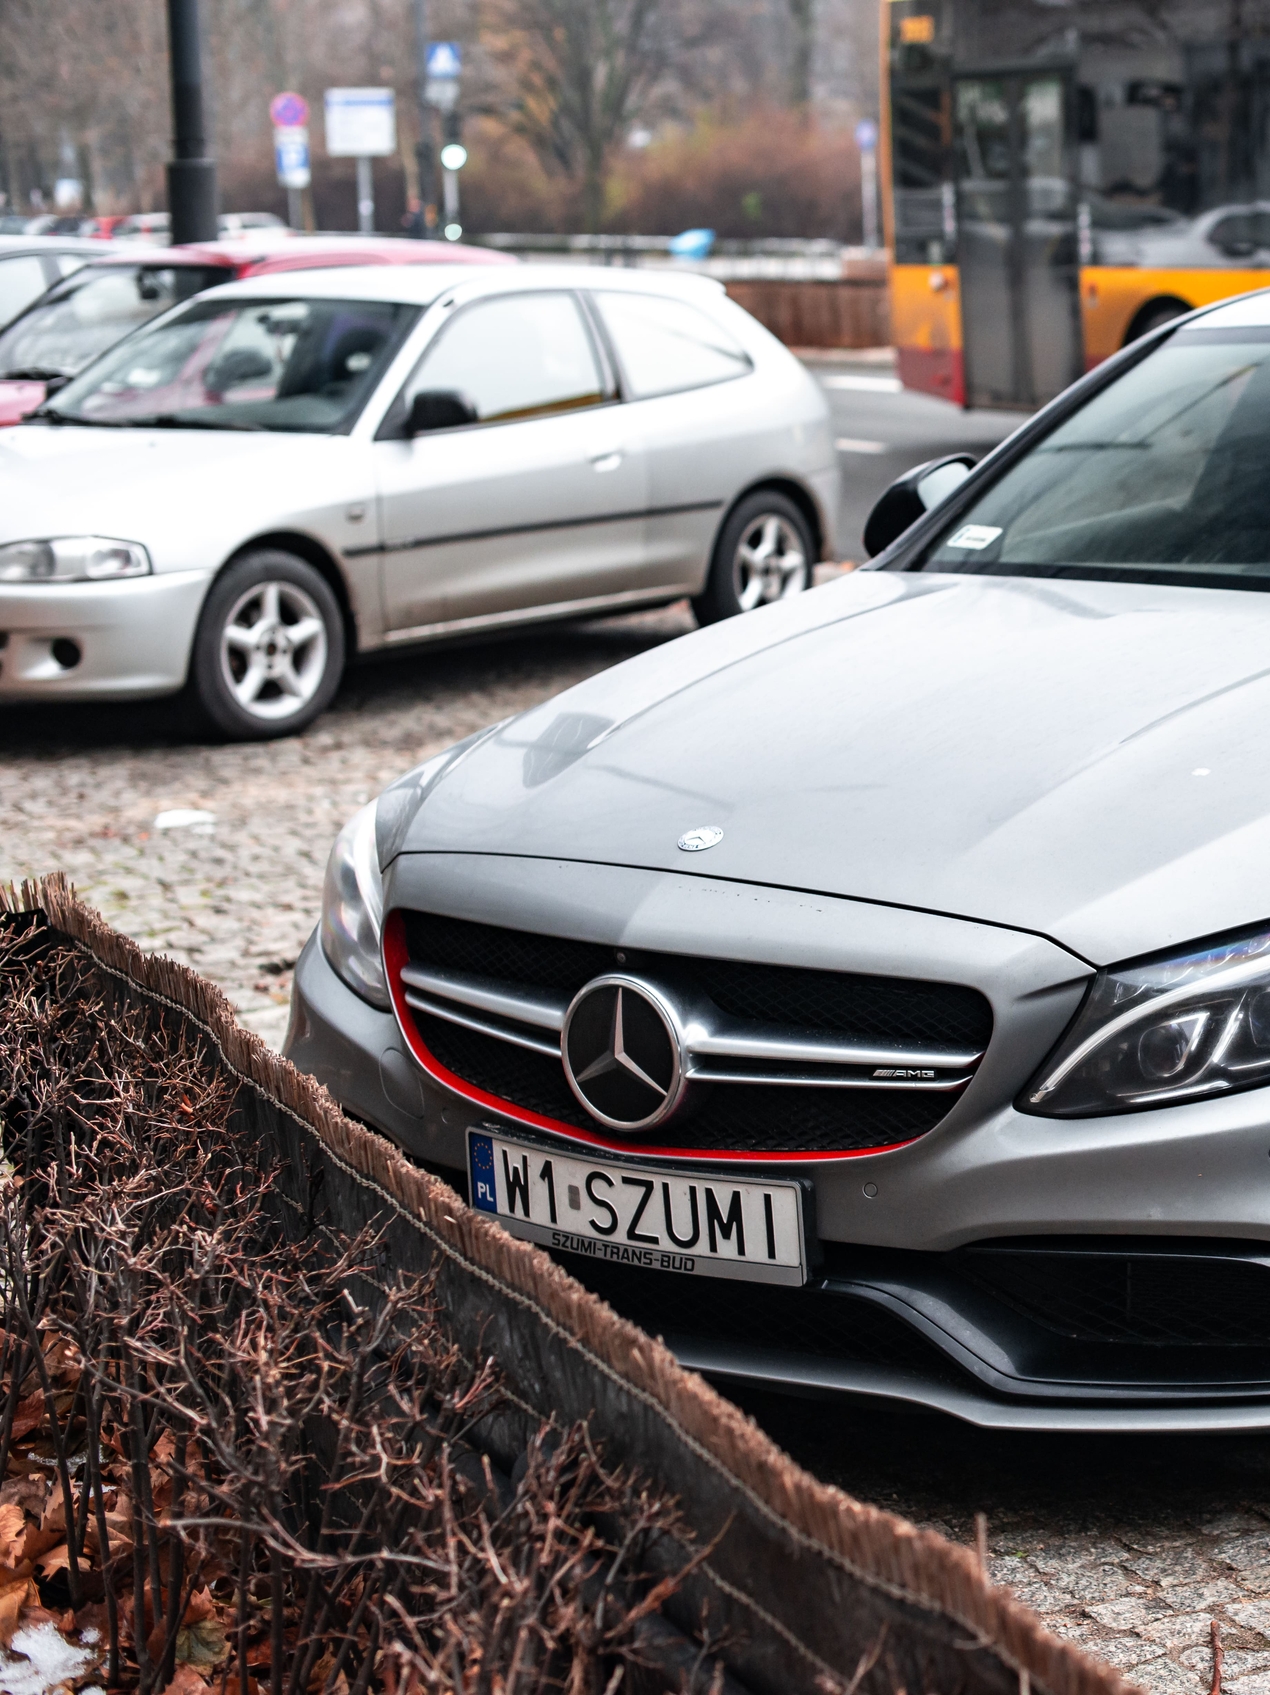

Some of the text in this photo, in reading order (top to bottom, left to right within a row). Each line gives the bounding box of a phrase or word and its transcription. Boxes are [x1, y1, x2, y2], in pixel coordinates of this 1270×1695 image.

[888, 1069, 935, 1078] AMG
[478, 1181, 494, 1202] PL
[502, 1148, 777, 1260] W1 SZUMI
[552, 1231, 695, 1272] SZUMI-TRANS-BUD
